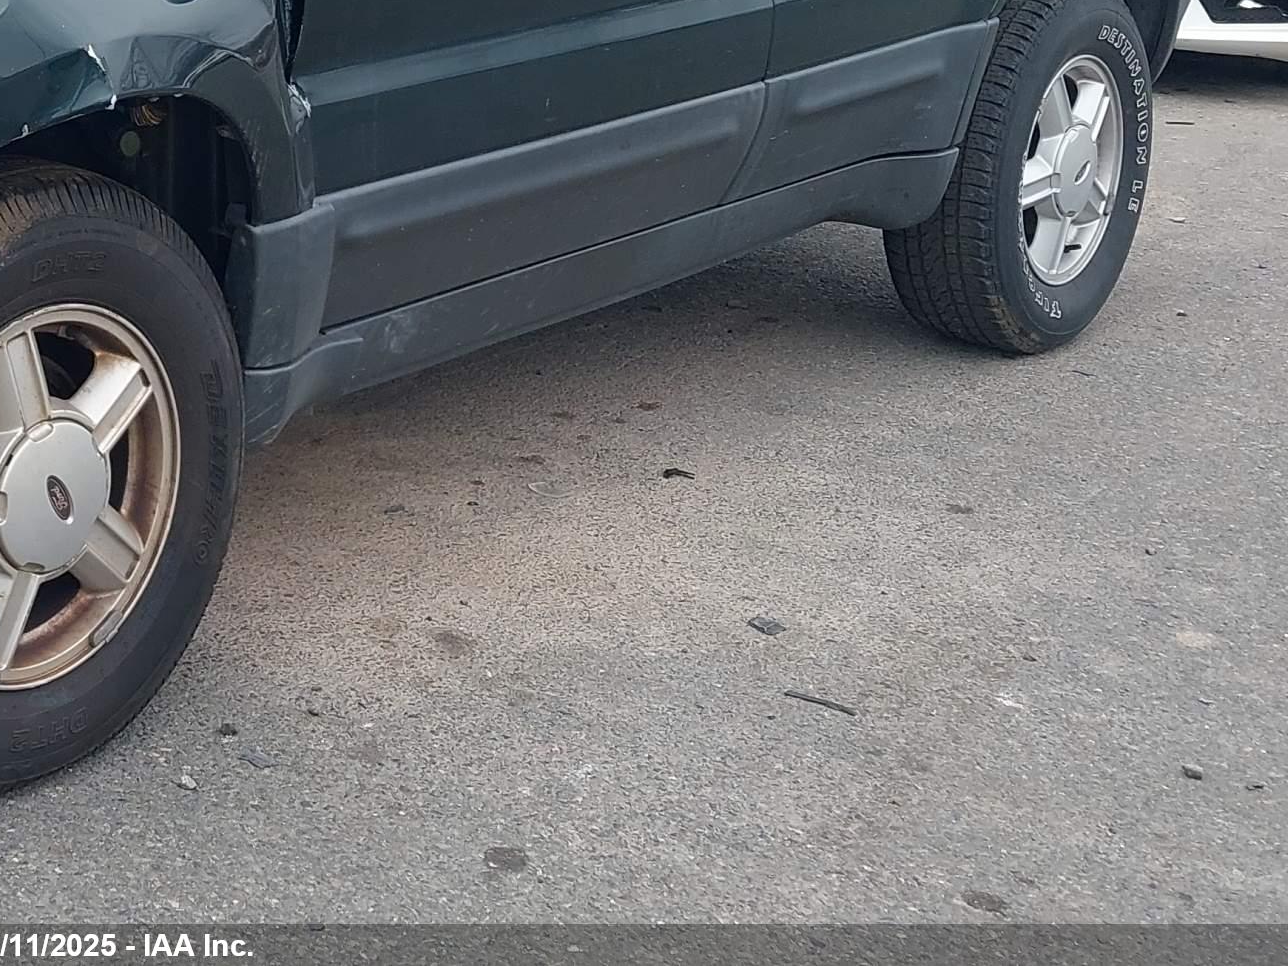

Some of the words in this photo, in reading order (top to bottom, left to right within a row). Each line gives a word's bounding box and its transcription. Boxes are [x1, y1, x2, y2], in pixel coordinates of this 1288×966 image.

[1097, 24, 1150, 165] DESTINATION
[1127, 179, 1144, 213] LE
[32, 250, 106, 283] DHT2
